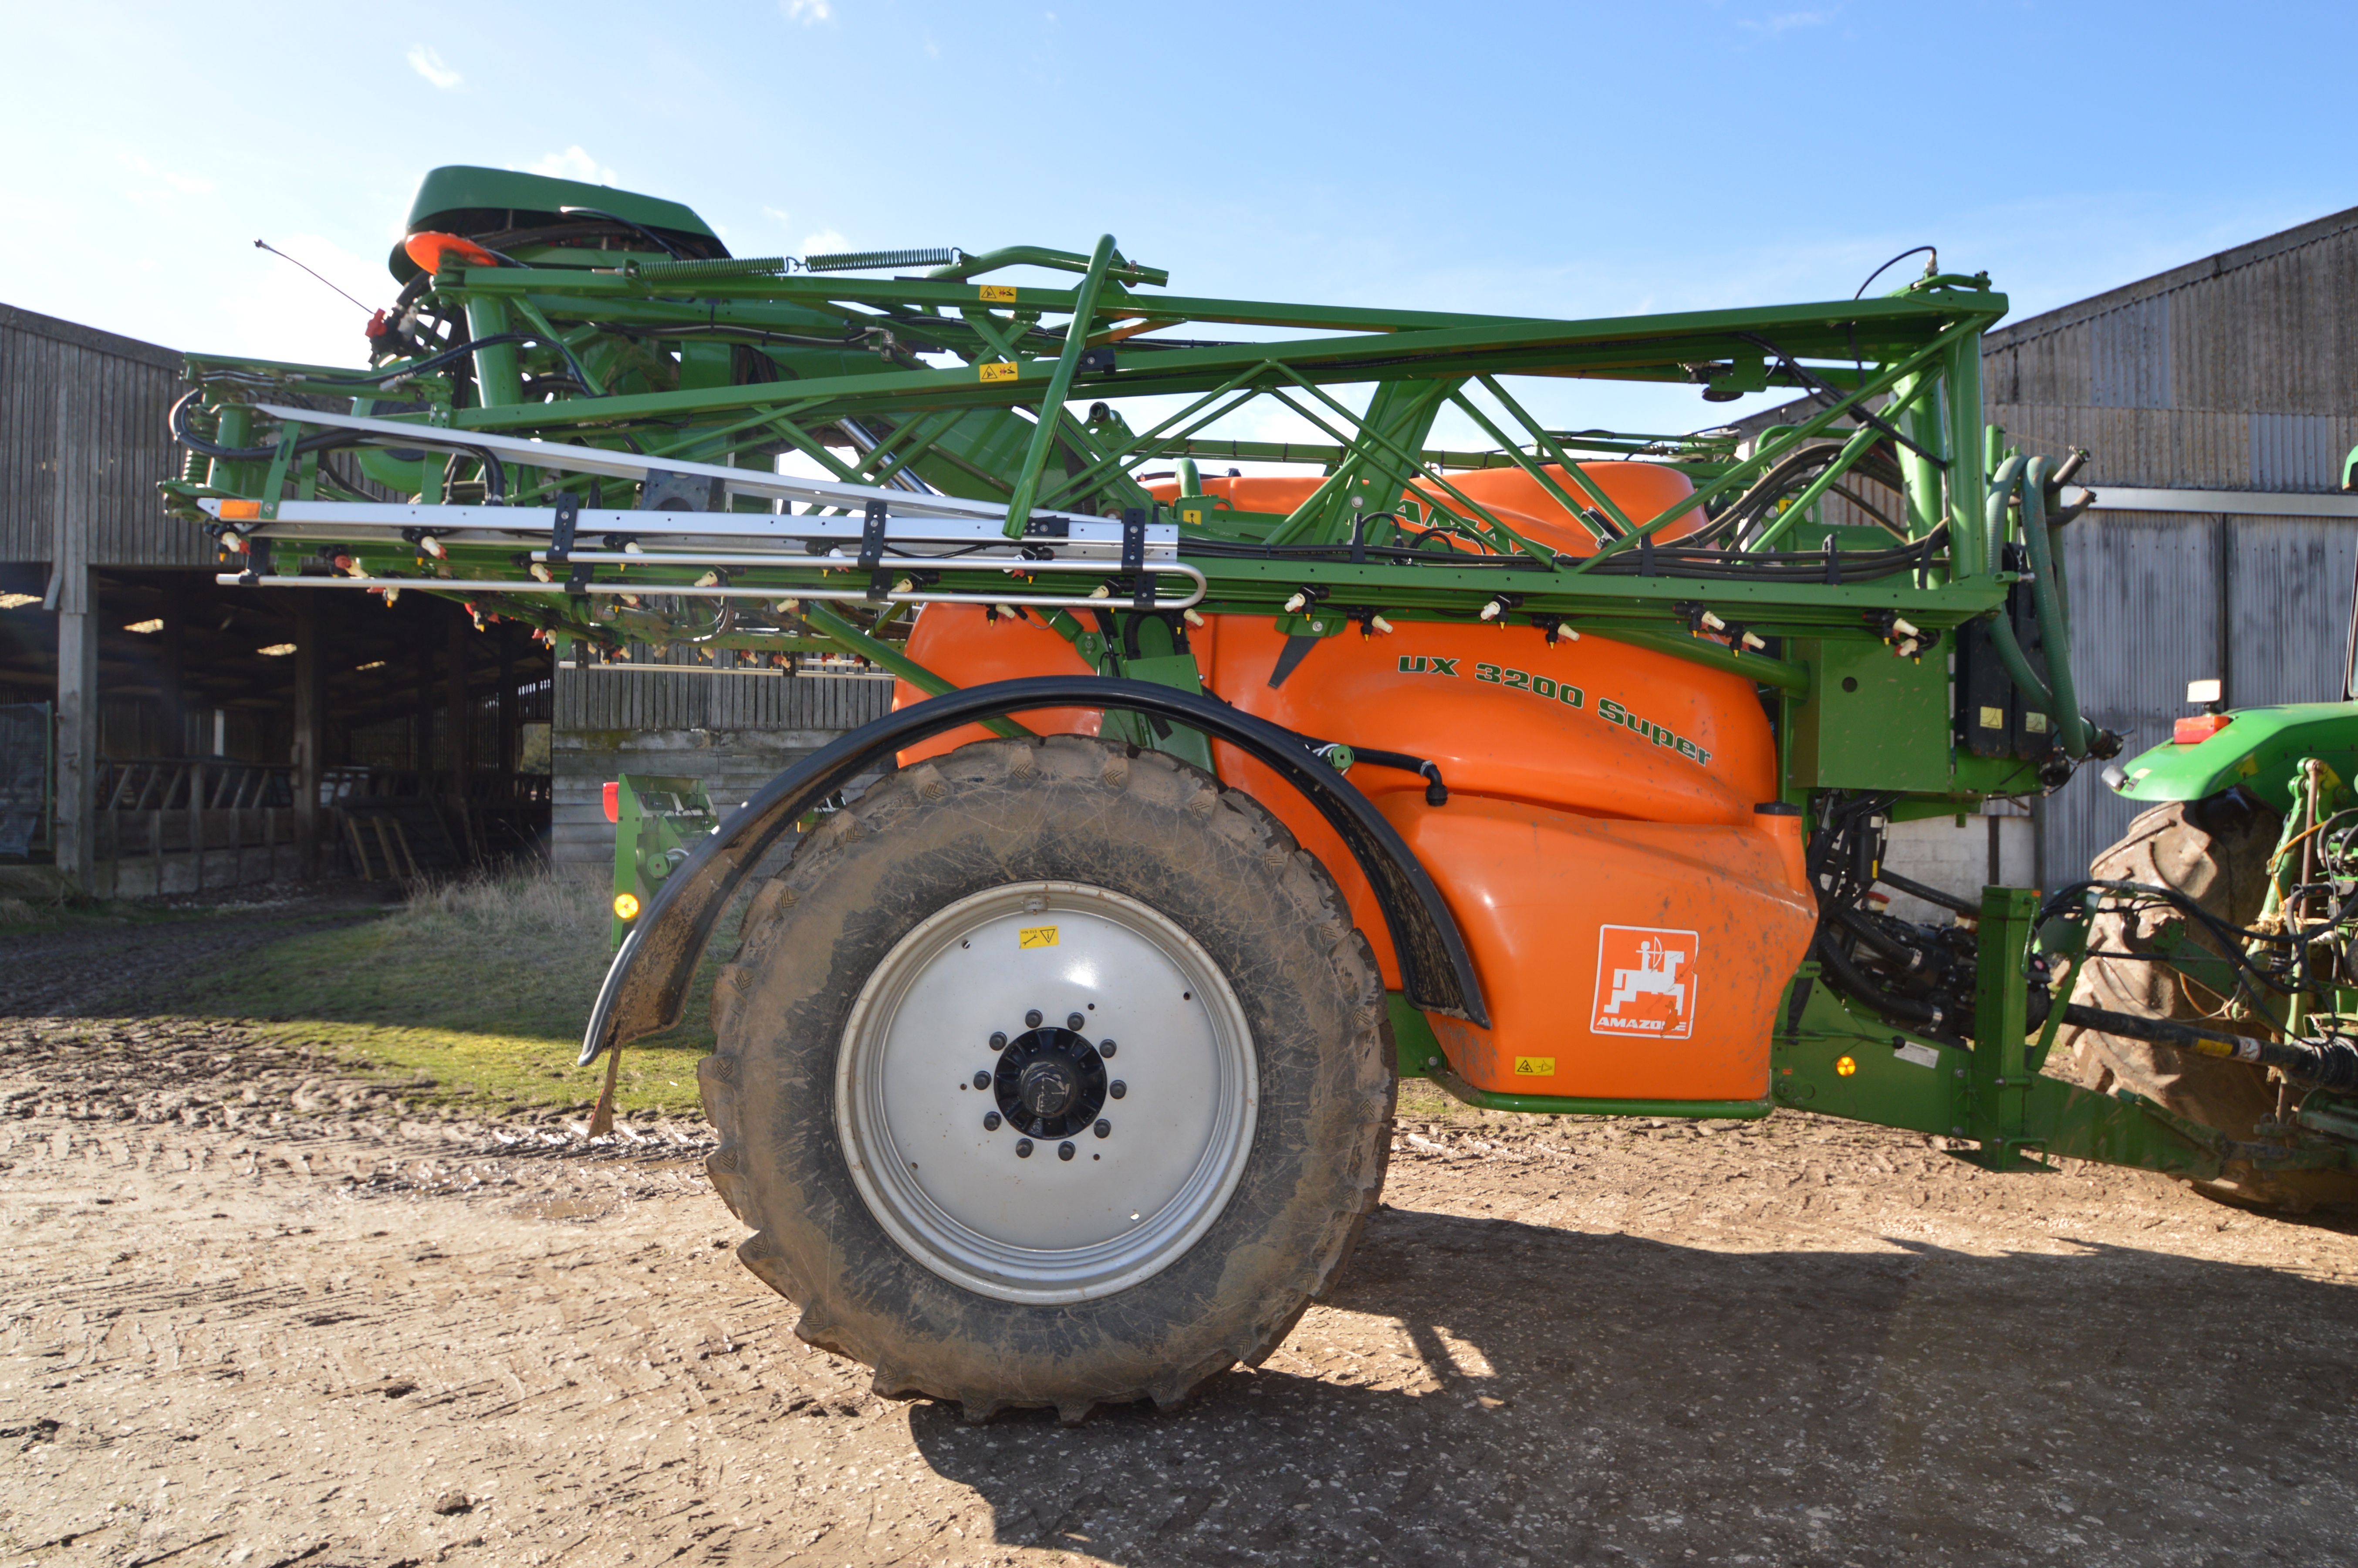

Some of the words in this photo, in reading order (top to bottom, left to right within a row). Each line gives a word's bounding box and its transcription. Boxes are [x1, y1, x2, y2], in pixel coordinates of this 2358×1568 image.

[1398, 656, 1461, 677] UX
[1475, 662, 1584, 709] 3200
[1598, 697, 1712, 767] Super
[1596, 1016, 1687, 1031] AMAZOE
